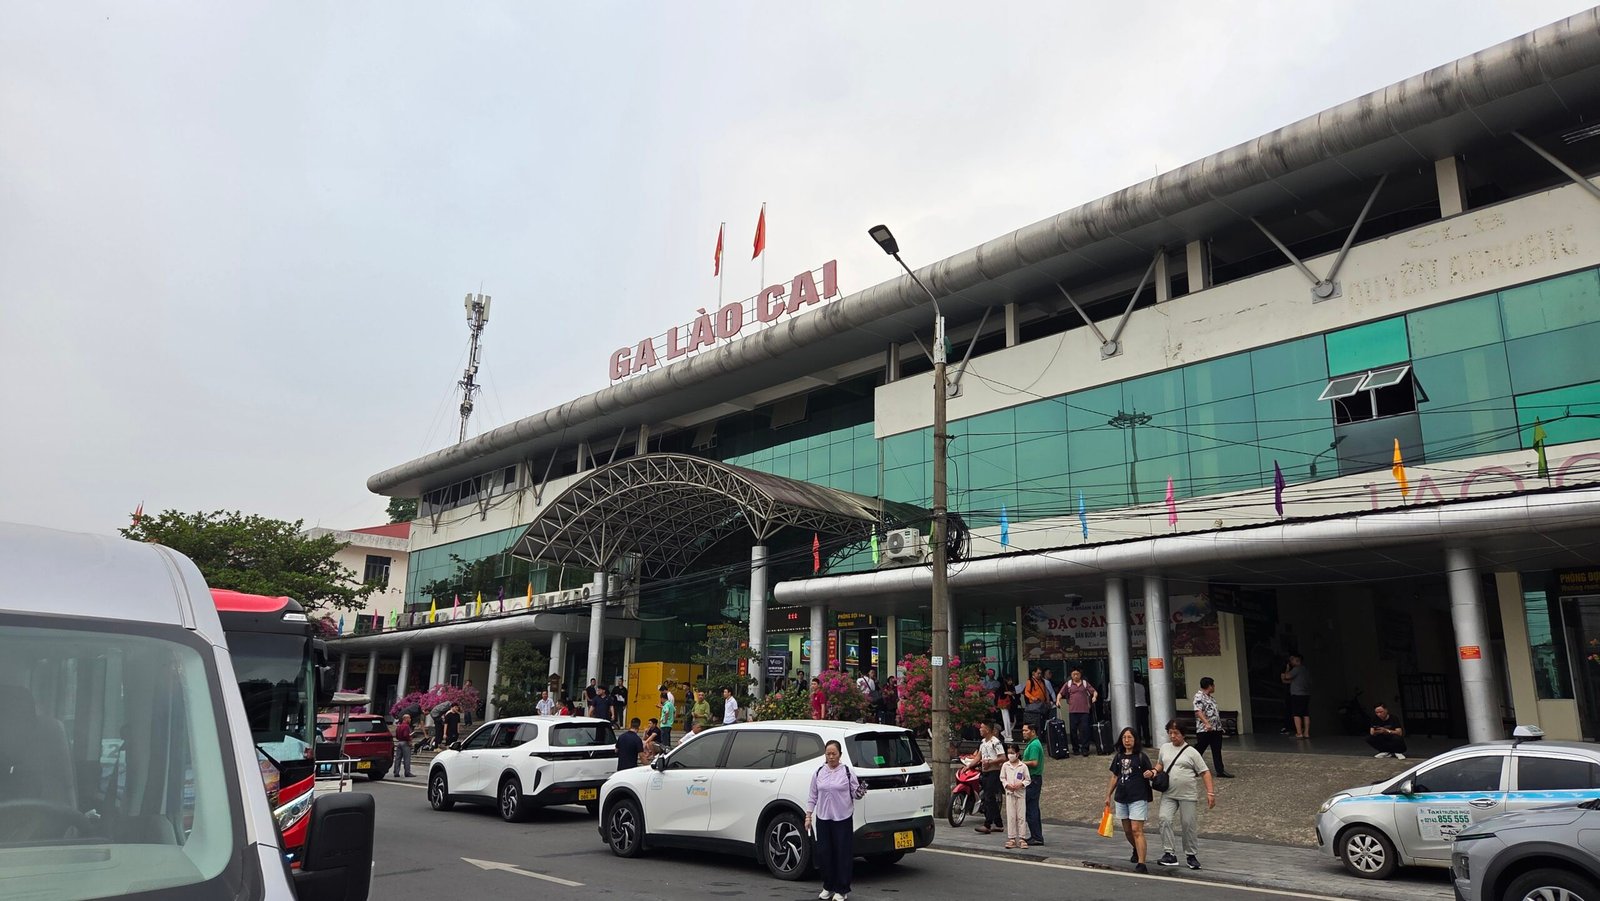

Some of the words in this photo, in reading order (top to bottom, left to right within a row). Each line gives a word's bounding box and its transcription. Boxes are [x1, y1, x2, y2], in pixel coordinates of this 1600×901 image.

[609, 338, 656, 380] GA
[667, 302, 743, 361] LÀO
[757, 259, 837, 323] CAI
[1048, 614, 1077, 632] ĐẶC
[1438, 814, 1453, 823] 855
[1454, 814, 1470, 823] 555
